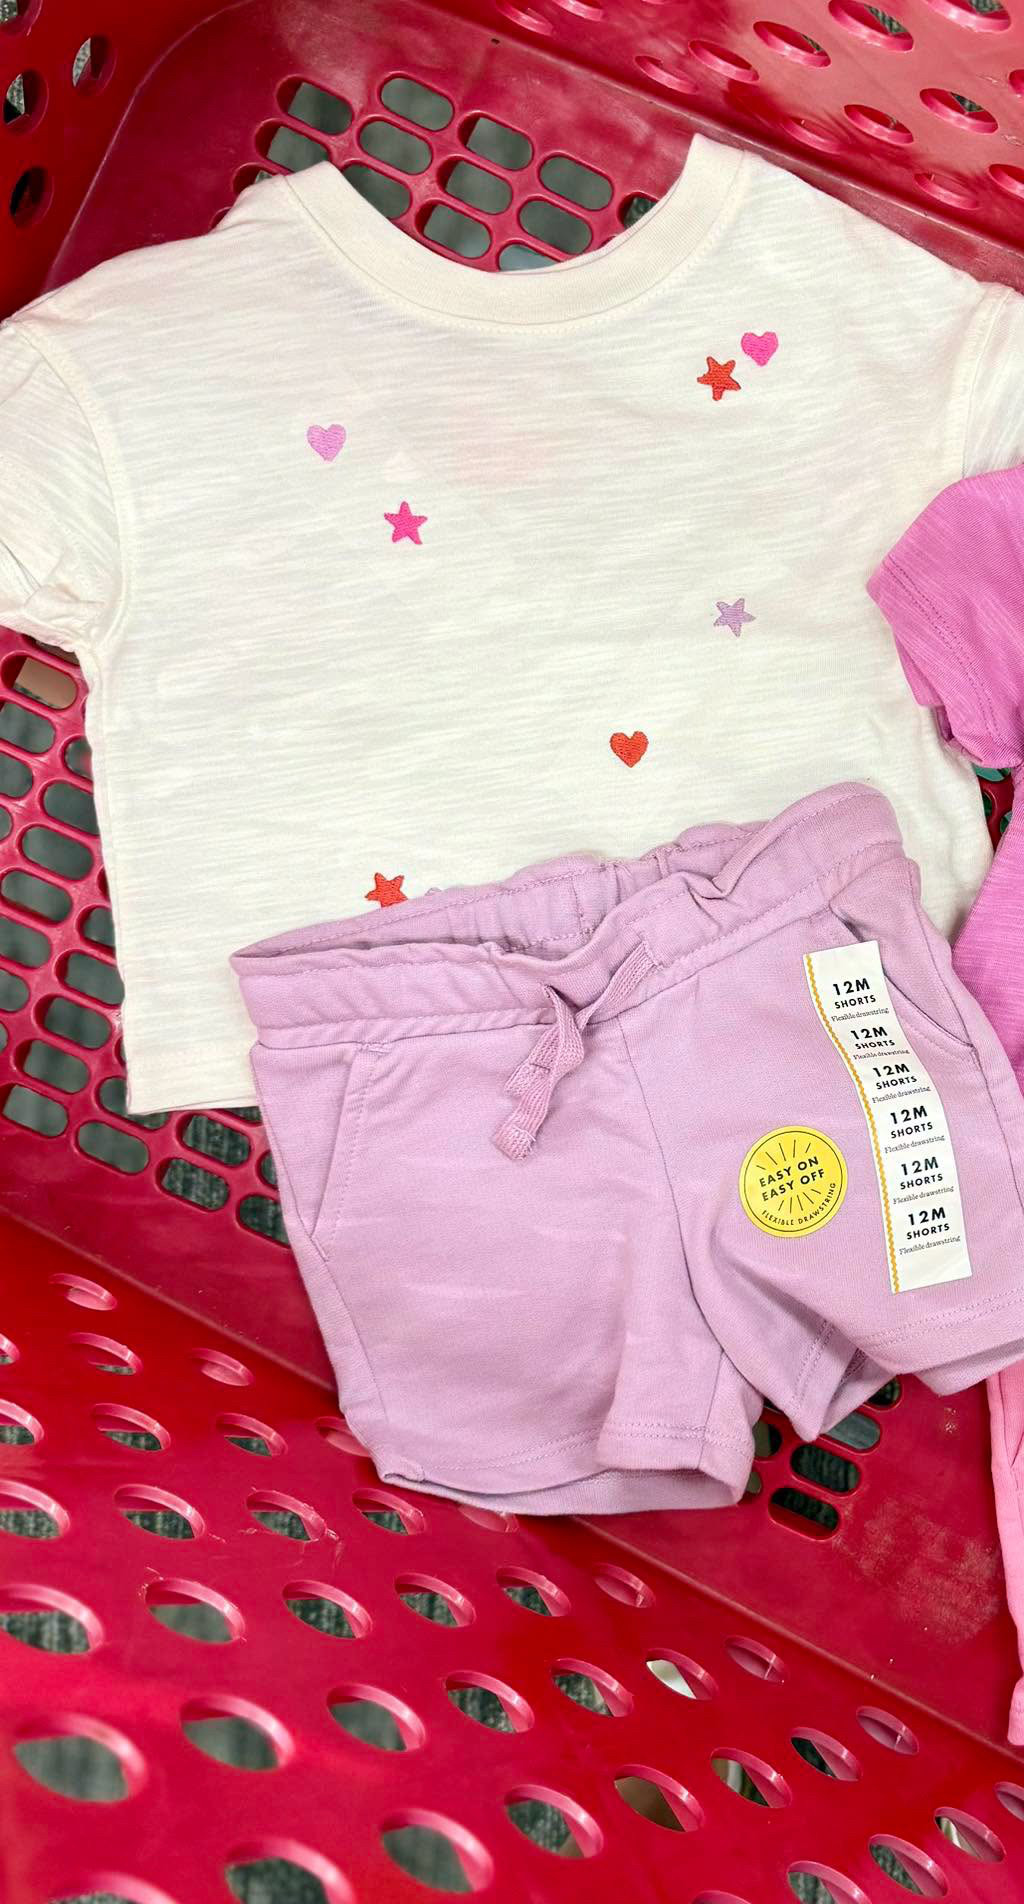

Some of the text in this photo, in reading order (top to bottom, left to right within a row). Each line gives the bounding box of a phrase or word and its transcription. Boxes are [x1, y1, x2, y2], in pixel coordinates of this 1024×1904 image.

[833, 978, 870, 995] 12M
[835, 995, 876, 1009] SHORTS
[831, 1012, 855, 1021] Flexible
[851, 1027, 888, 1040] 12M
[856, 1039, 895, 1049] SHORTS
[873, 1063, 909, 1077] 12M
[876, 1076, 917, 1089] SHORTS
[872, 1093, 897, 1103] Flexible
[891, 1106, 927, 1124] 12M
[891, 1122, 933, 1138] SHORTS
[885, 1143, 910, 1153] Flexible
[760, 1156, 818, 1187] EASY ON
[901, 1156, 939, 1175] 12M
[762, 1169, 824, 1201] EASY OFF
[900, 1174, 943, 1189] SHORTS
[762, 1183, 836, 1225] FLEXIBLE DRAWSTRING
[893, 1194, 918, 1204] Flexible
[908, 1207, 945, 1225] 12M
[907, 1223, 950, 1239] SHORTS
[899, 1244, 925, 1255] Flexible
